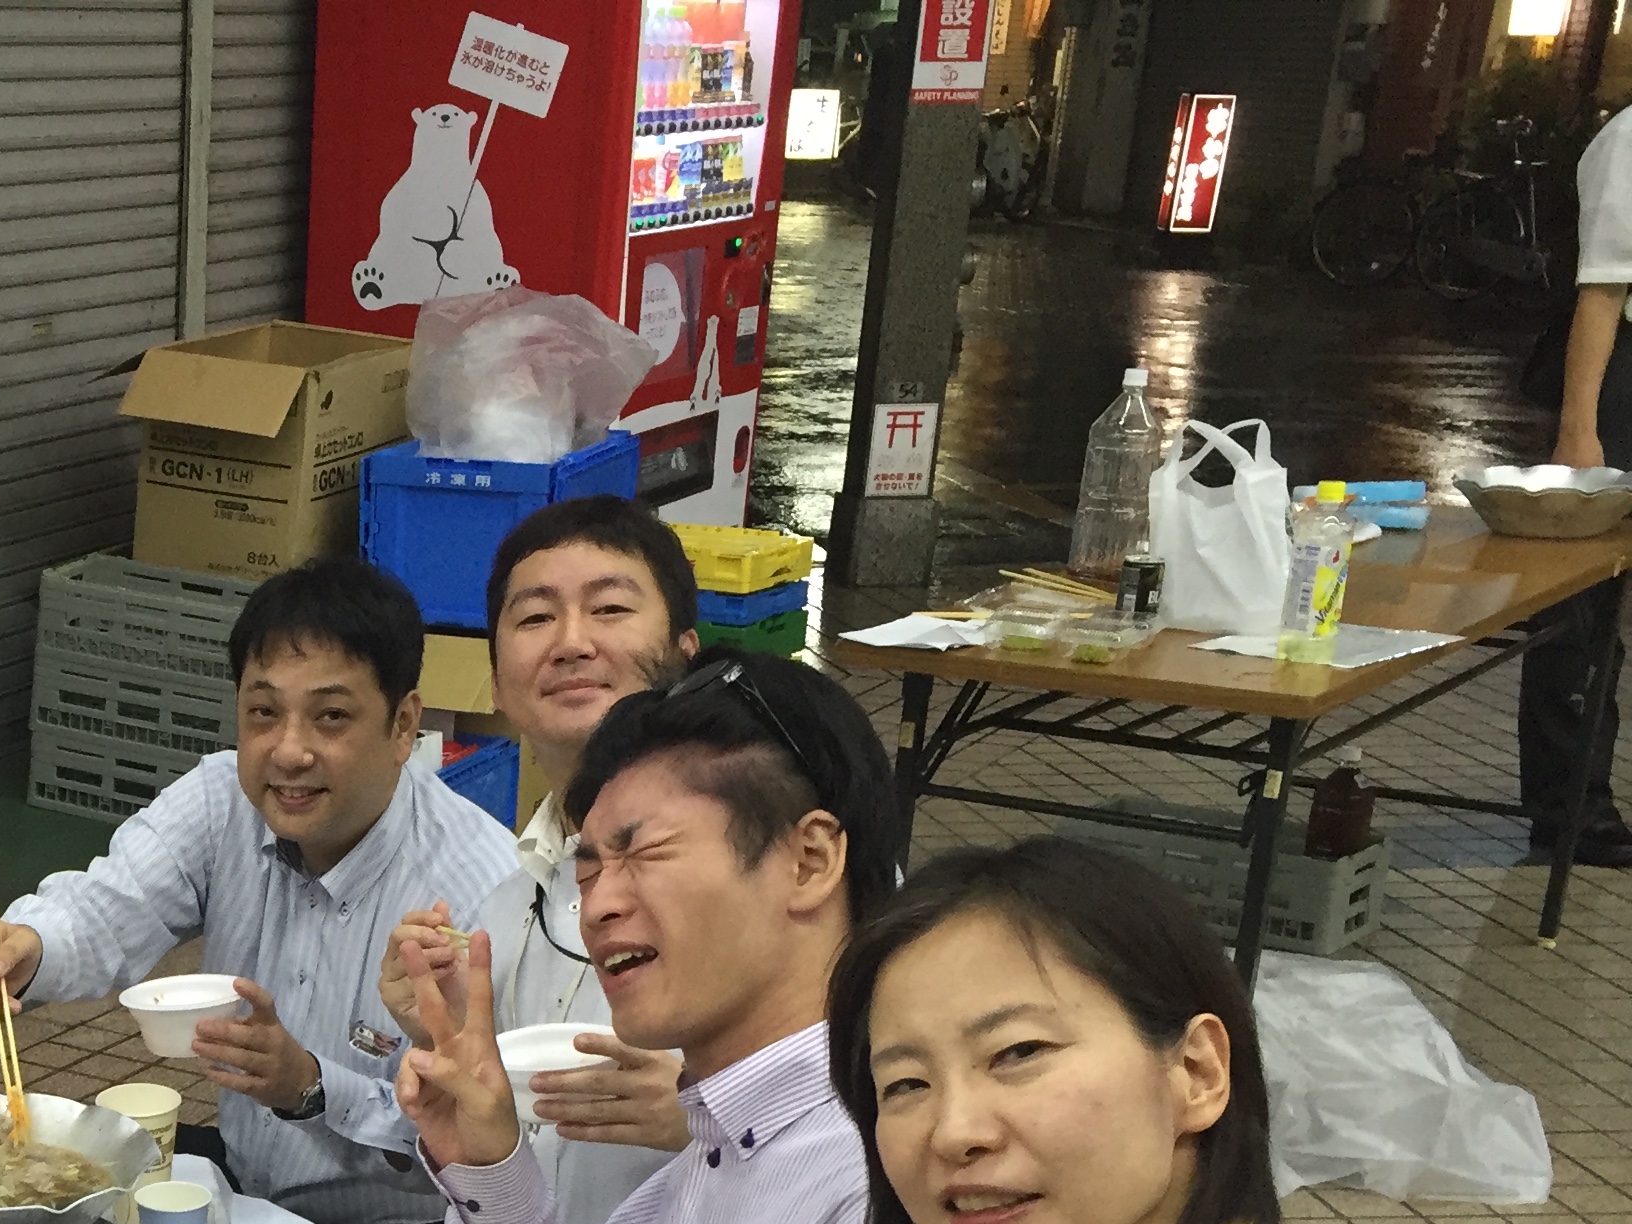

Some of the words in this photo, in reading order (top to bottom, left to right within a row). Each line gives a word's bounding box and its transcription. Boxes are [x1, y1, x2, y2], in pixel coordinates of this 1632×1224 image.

[936, 0, 976, 59] 設置
[470, 35, 551, 76] 温暖化が進むと
[914, 91, 941, 101] SAFETY
[898, 383, 918, 399] 54
[247, 550, 281, 569] 8台入
